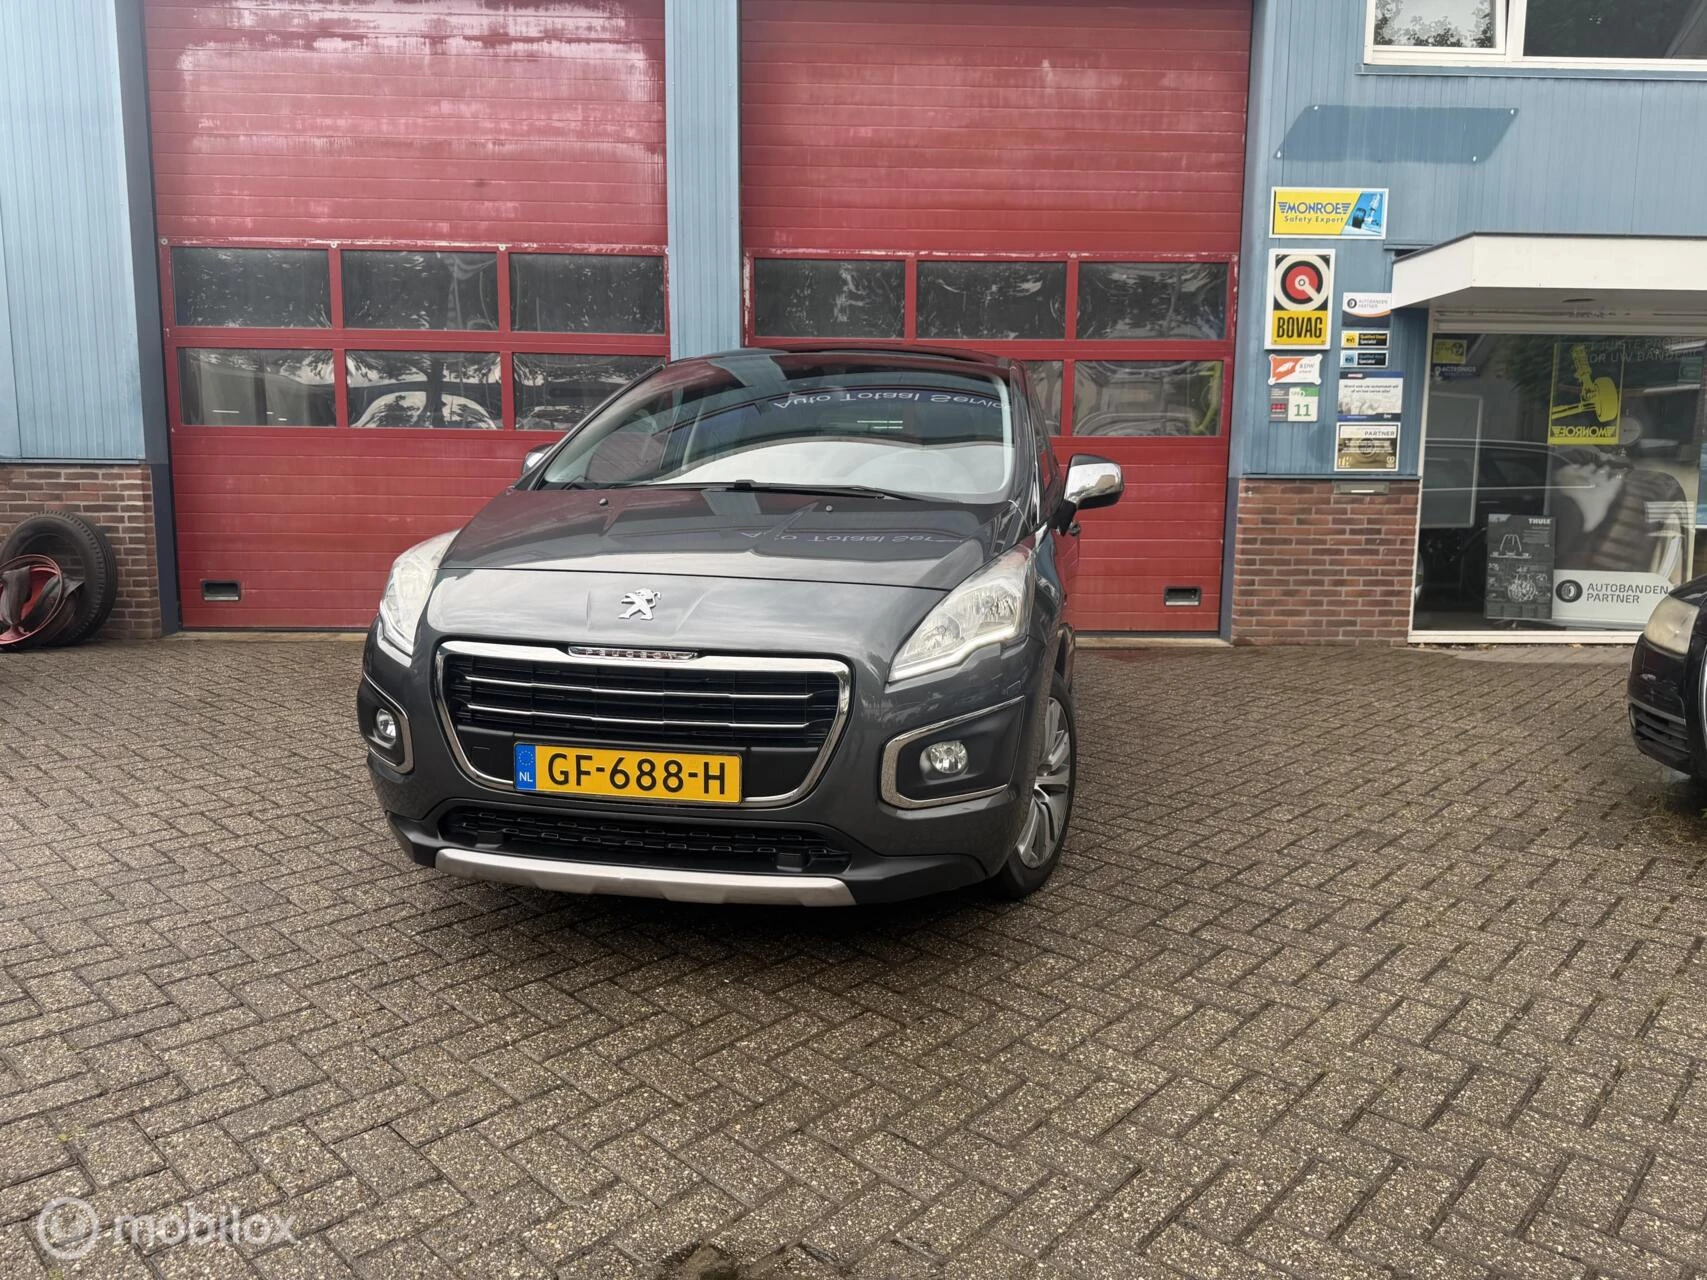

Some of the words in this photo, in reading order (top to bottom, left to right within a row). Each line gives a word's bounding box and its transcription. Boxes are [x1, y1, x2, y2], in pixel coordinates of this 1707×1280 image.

[1286, 202, 1342, 214] MONROE
[1284, 215, 1312, 224] Safety
[1315, 216, 1344, 224] Expert
[1276, 316, 1323, 339] BOVAG
[1294, 403, 1312, 417] 11
[1586, 583, 1669, 595] AUTOBANDEN
[1586, 593, 1640, 604] PARTNER
[519, 771, 533, 783] NL
[547, 752, 726, 795] GF-688-H
